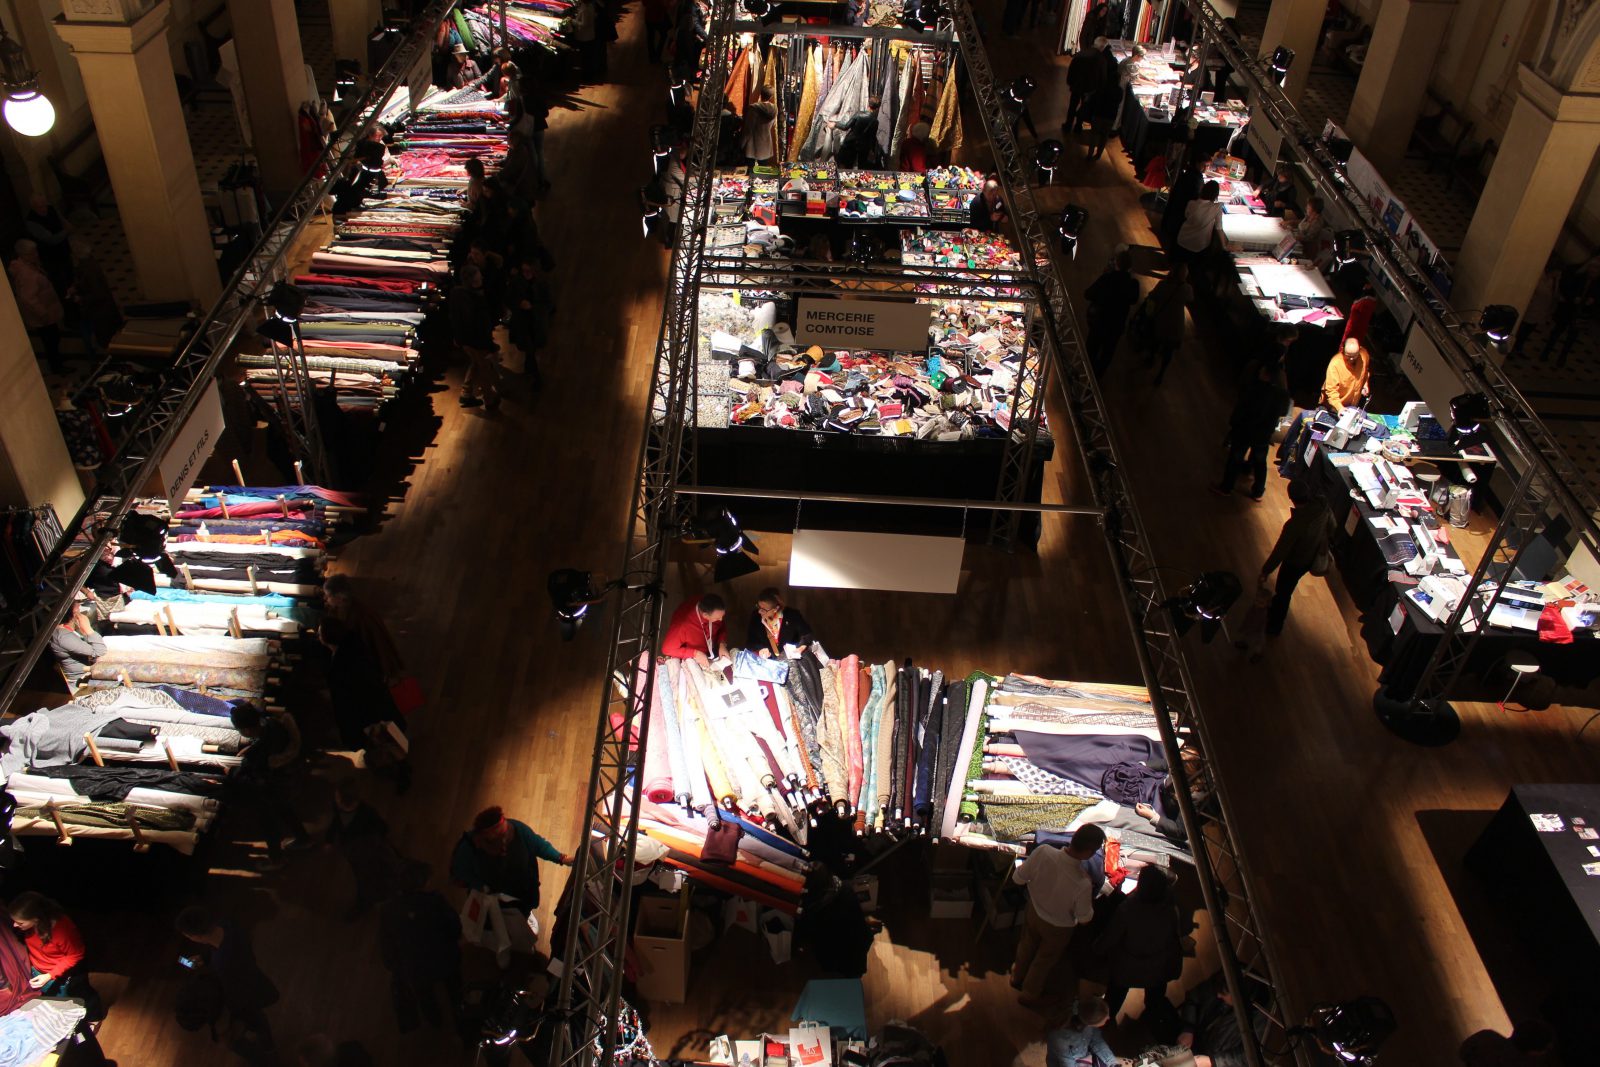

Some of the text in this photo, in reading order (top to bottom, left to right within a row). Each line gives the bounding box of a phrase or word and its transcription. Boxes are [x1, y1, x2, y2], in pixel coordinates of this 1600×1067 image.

[806, 311, 875, 323] MERCERIE
[806, 324, 874, 336] COMTOISE
[1407, 351, 1423, 374] PFAFF
[170, 430, 209, 497] DENIS ET FILS
